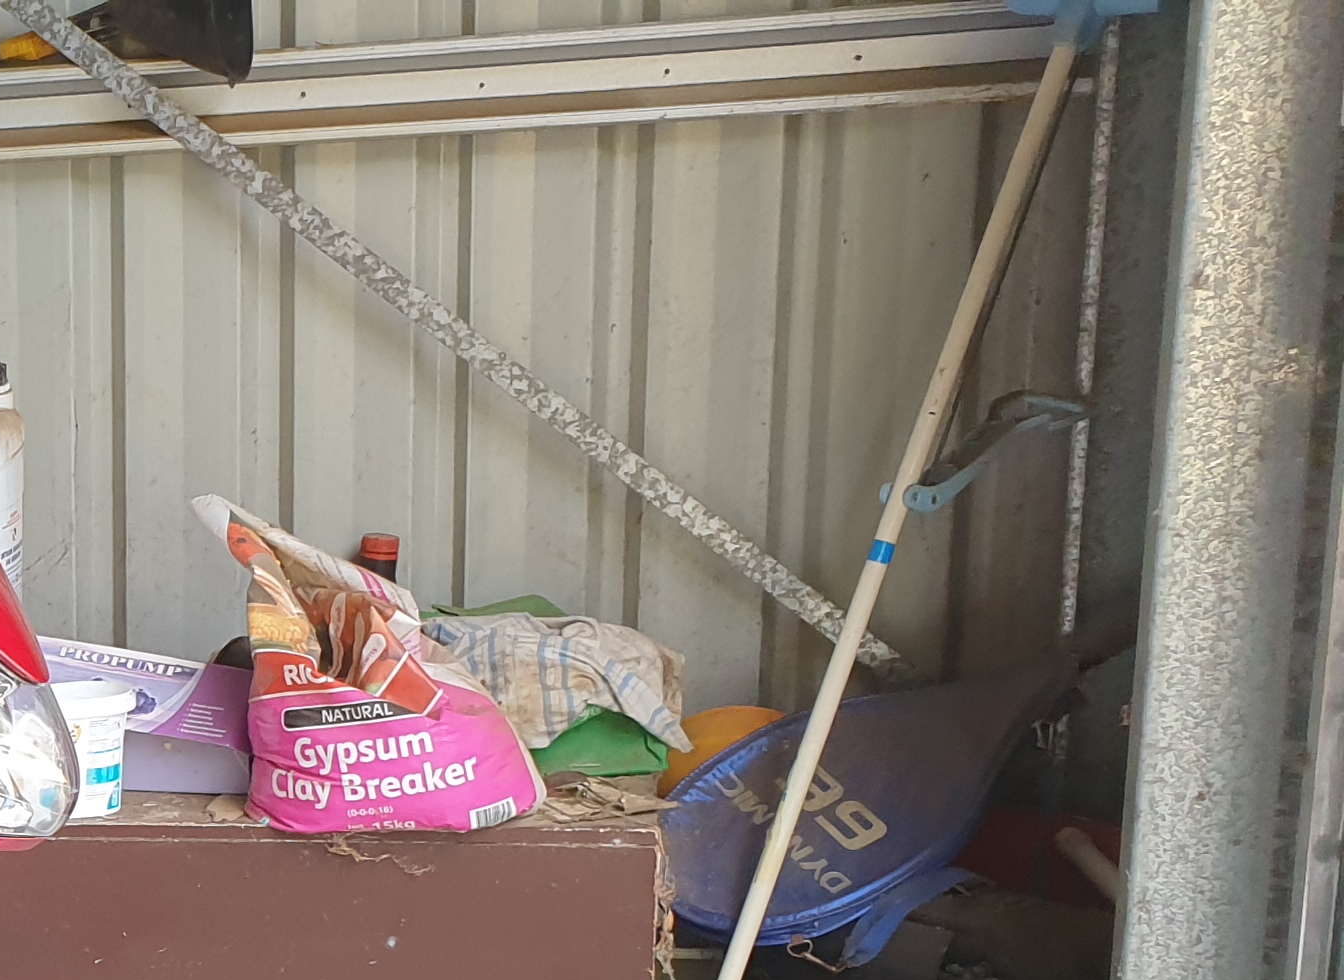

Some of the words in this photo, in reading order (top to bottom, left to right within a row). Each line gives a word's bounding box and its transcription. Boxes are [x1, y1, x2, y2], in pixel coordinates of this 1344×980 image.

[60, 646, 183, 677] PROPUMP
[283, 662, 334, 687] RIC
[321, 702, 394, 724] NATURAL
[294, 730, 434, 776] Gypsum
[271, 769, 331, 810] Clay
[340, 756, 477, 803] Breaker
[714, 770, 852, 894] DYNMIC
